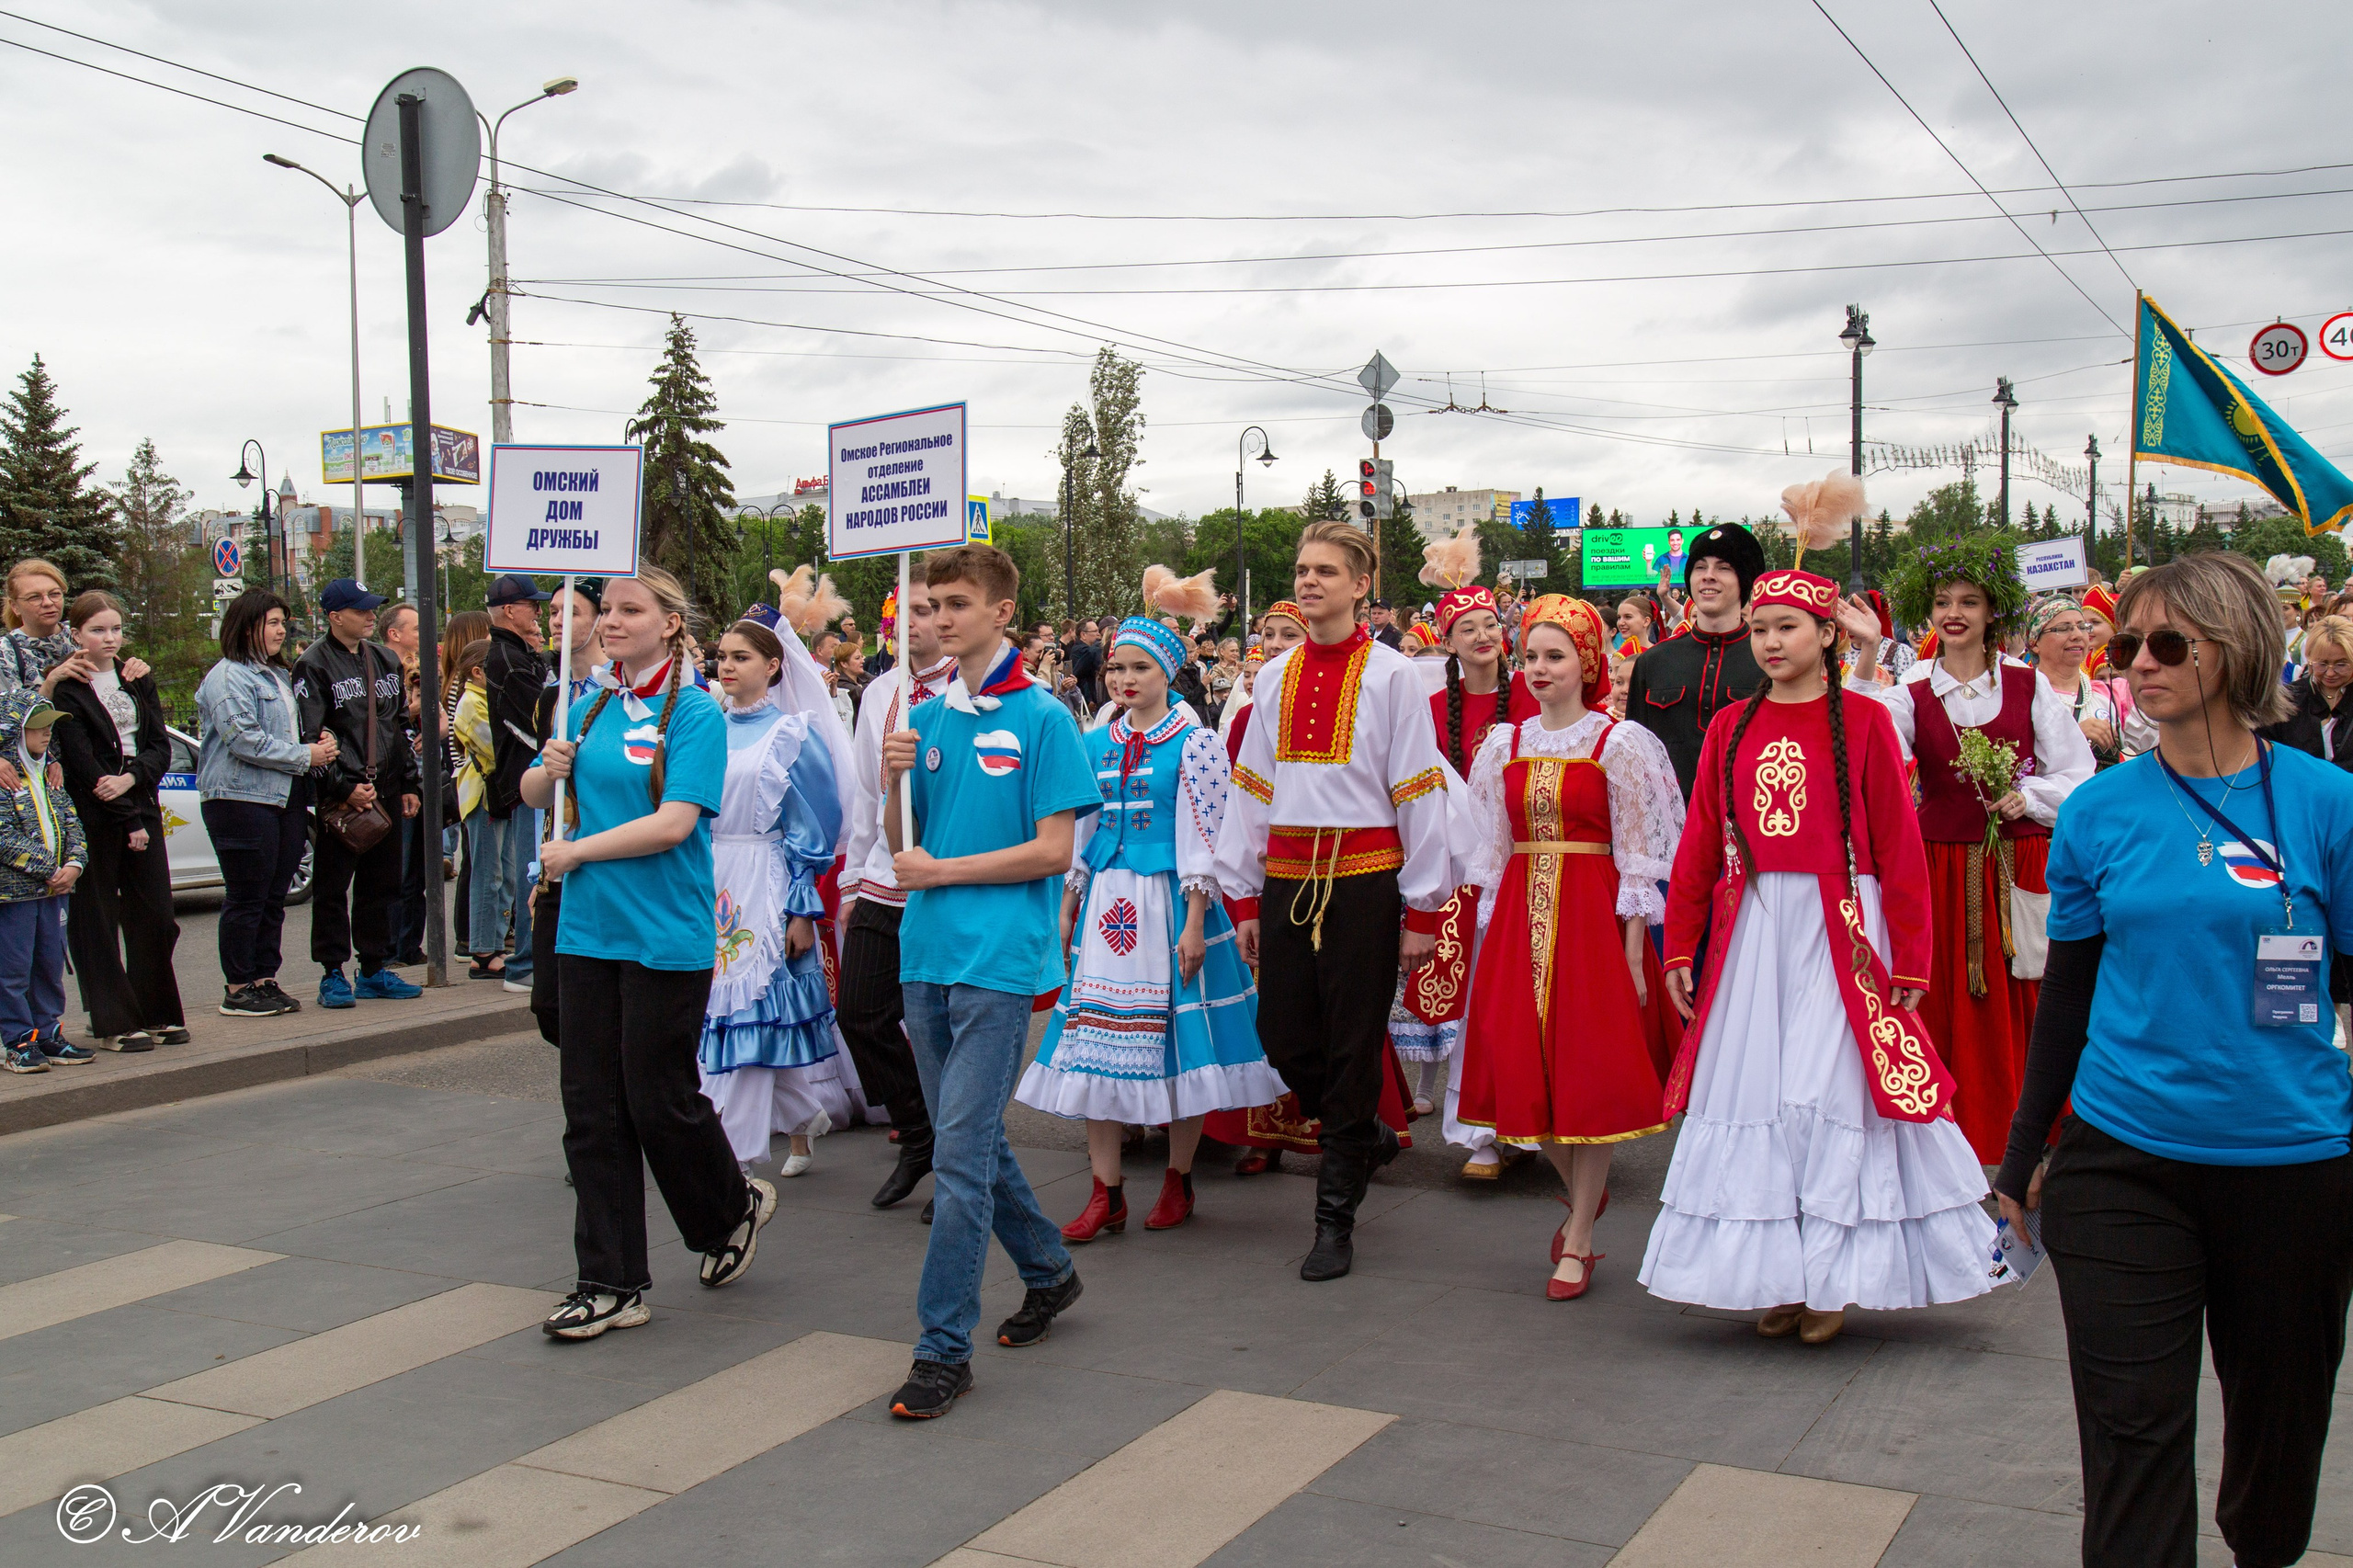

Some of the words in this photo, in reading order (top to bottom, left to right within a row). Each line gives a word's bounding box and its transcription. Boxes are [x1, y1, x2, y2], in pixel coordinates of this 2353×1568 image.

[2330, 327, 2353, 347] 4
[841, 446, 878, 462] Омское
[880, 433, 953, 457] Региональное
[533, 469, 599, 492] ОМСКИЙ
[868, 459, 924, 479] отделение
[861, 477, 931, 503] АССАМБЛЕИ
[545, 500, 583, 523] ДОМ
[846, 505, 898, 530] НАРОДОВ
[901, 499, 948, 523] РОССИИ
[526, 528, 599, 551] ДРУЖБЫ
[2027, 559, 2075, 574] КАЗАХСТАН
[2035, 553, 2064, 562] РЕСПУБЛИКА
